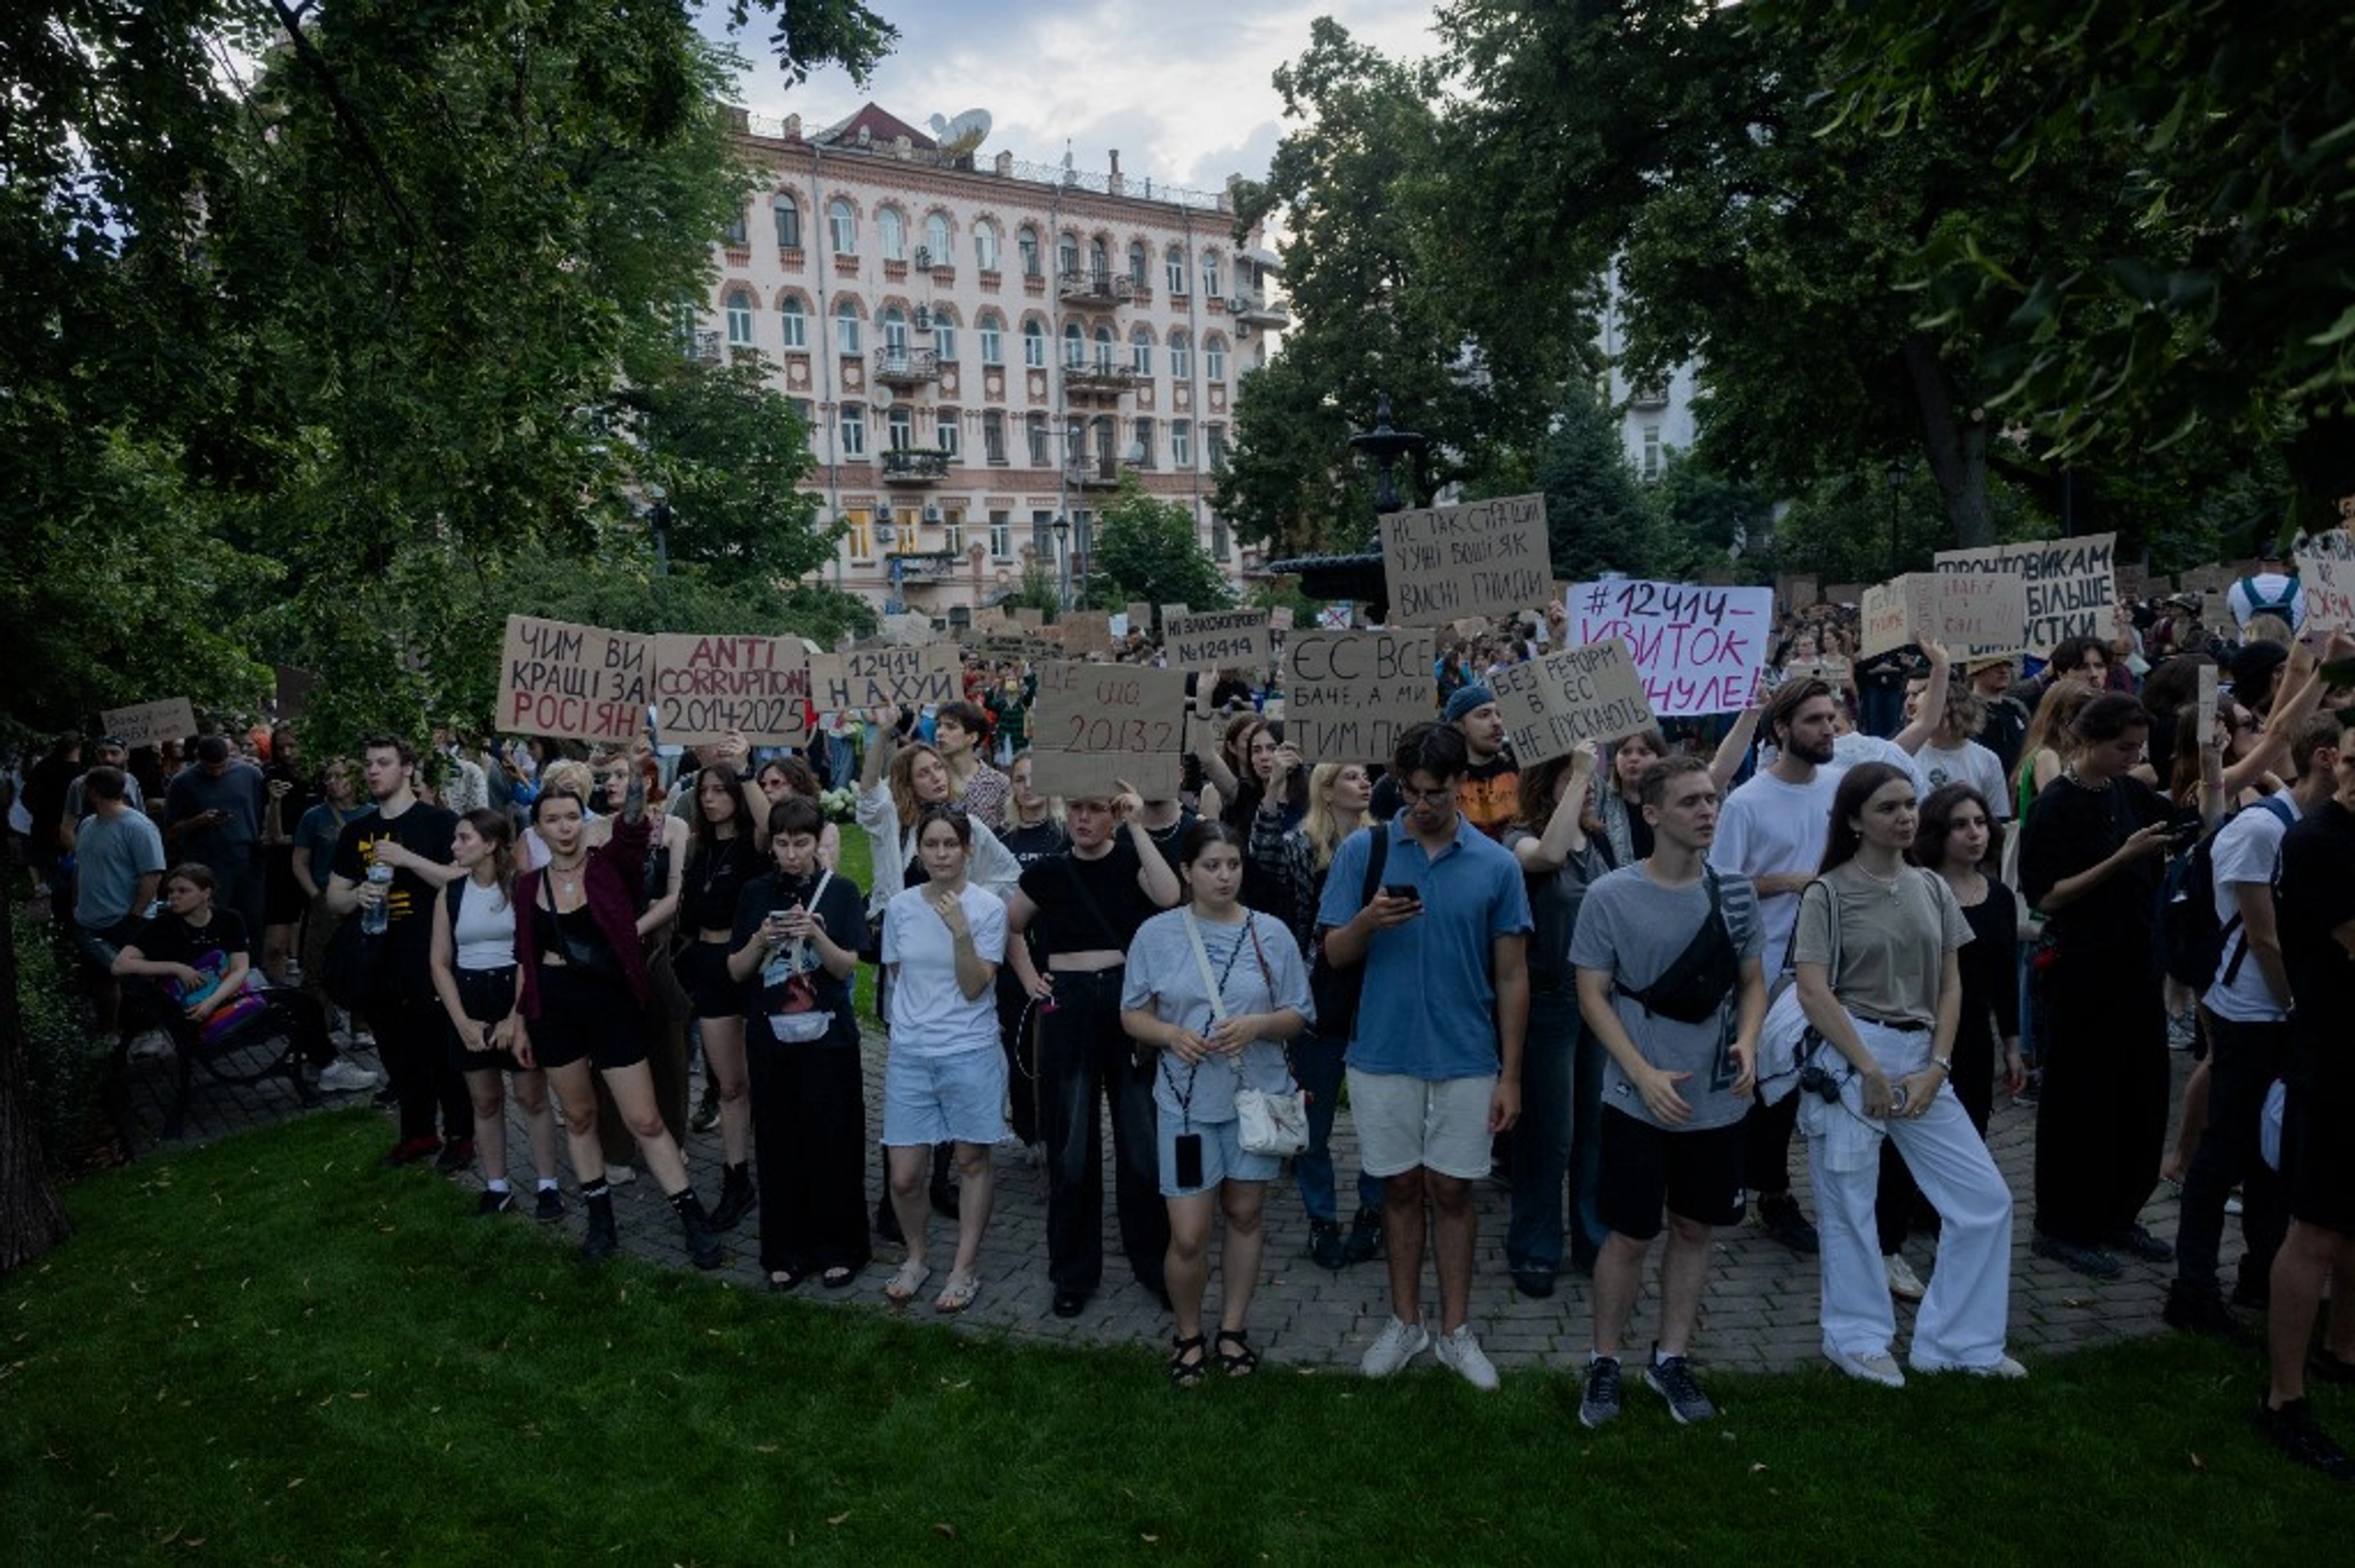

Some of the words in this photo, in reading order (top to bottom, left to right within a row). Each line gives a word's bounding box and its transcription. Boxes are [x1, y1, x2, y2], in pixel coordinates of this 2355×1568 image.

[1392, 515, 1417, 543] НЕ
[1426, 512, 1465, 535] ТАК
[1498, 532, 1528, 559] ЯК
[2027, 576, 2113, 616] БІЛЬШЕ
[521, 624, 583, 662] ЧИМ
[605, 636, 646, 671] ВИ
[688, 636, 775, 668] ANTI
[848, 651, 920, 677] 12414
[1292, 636, 1360, 681] ЄС
[1377, 636, 1432, 679] ВСЕ
[511, 659, 601, 699] КРАЩІ
[610, 672, 646, 704] ЗА
[659, 667, 804, 695] CORRUPTION
[1042, 666, 1078, 694] ЦЕ
[1492, 664, 1537, 697] БЕЗ
[1545, 644, 1618, 681] РЕФОРМ
[1294, 687, 1361, 708] БАЧЕ,
[1368, 686, 1382, 705] А
[1396, 685, 1427, 703] МИ
[1564, 676, 1592, 703] ЄС
[513, 692, 637, 737] РОСІЯН
[1513, 724, 1546, 760] НЕ
[1548, 696, 1648, 748] ПУСКАЮТЬ
[1291, 720, 1360, 756] ТИМ
